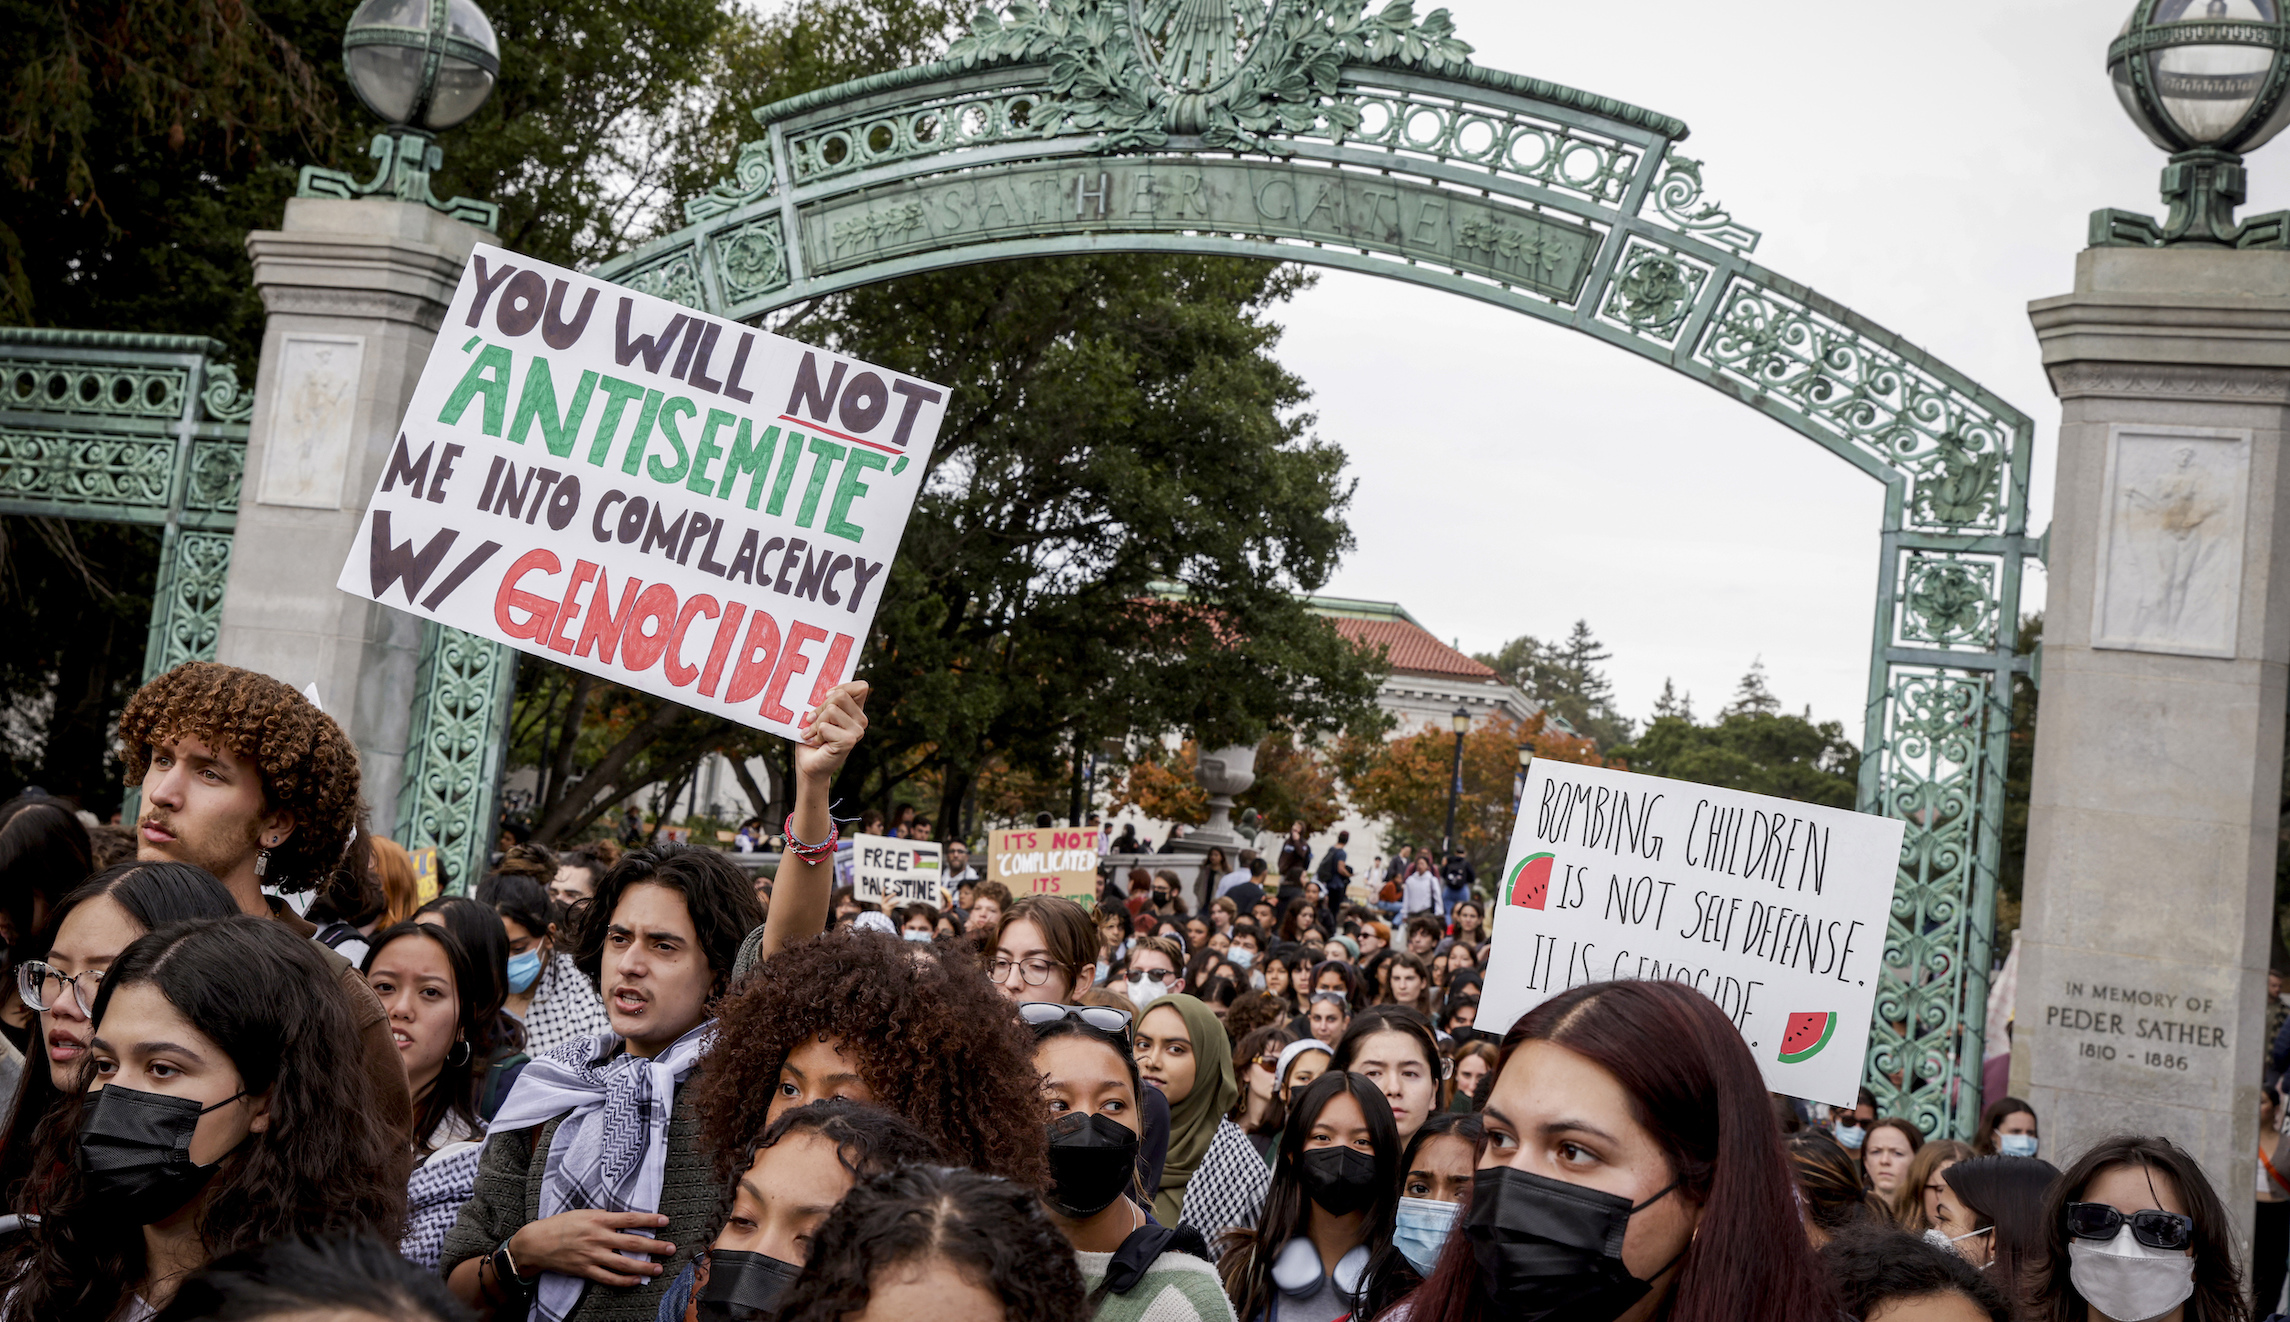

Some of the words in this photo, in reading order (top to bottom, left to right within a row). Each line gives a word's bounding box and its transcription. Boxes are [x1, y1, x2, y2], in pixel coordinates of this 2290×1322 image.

[942, 171, 1208, 230] SATHER
[1252, 177, 1443, 247] GATE
[465, 254, 600, 350] YOU
[615, 297, 756, 404] WILL
[785, 351, 943, 446] NOT
[380, 431, 466, 504] ME
[476, 455, 582, 531] INTO
[592, 489, 883, 614] COMPLACENCY
[369, 510, 503, 612] W/
[494, 548, 855, 730] GENOCIDE!
[864, 847, 910, 872] FREE
[1052, 831, 1098, 850] NOT
[1537, 778, 1664, 861] BOMBING
[1686, 800, 1829, 896] CHILDREN
[862, 876, 936, 901] PALESTINE
[1556, 864, 1588, 909] IS
[1604, 874, 1676, 930] NOT
[1680, 890, 1742, 951] SELF
[1743, 900, 1864, 986] DEFENSE.
[1526, 934, 1557, 993] IT
[1567, 942, 1595, 989] IS
[2065, 980, 2084, 997] IN
[2092, 985, 2178, 1009] MEMORY
[2186, 997, 2213, 1013] OF
[2046, 1005, 2126, 1036] PEDER
[2135, 1018, 2229, 1049] SATHER
[2079, 1042, 2117, 1062] 1810
[2144, 1052, 2190, 1072] 1886
